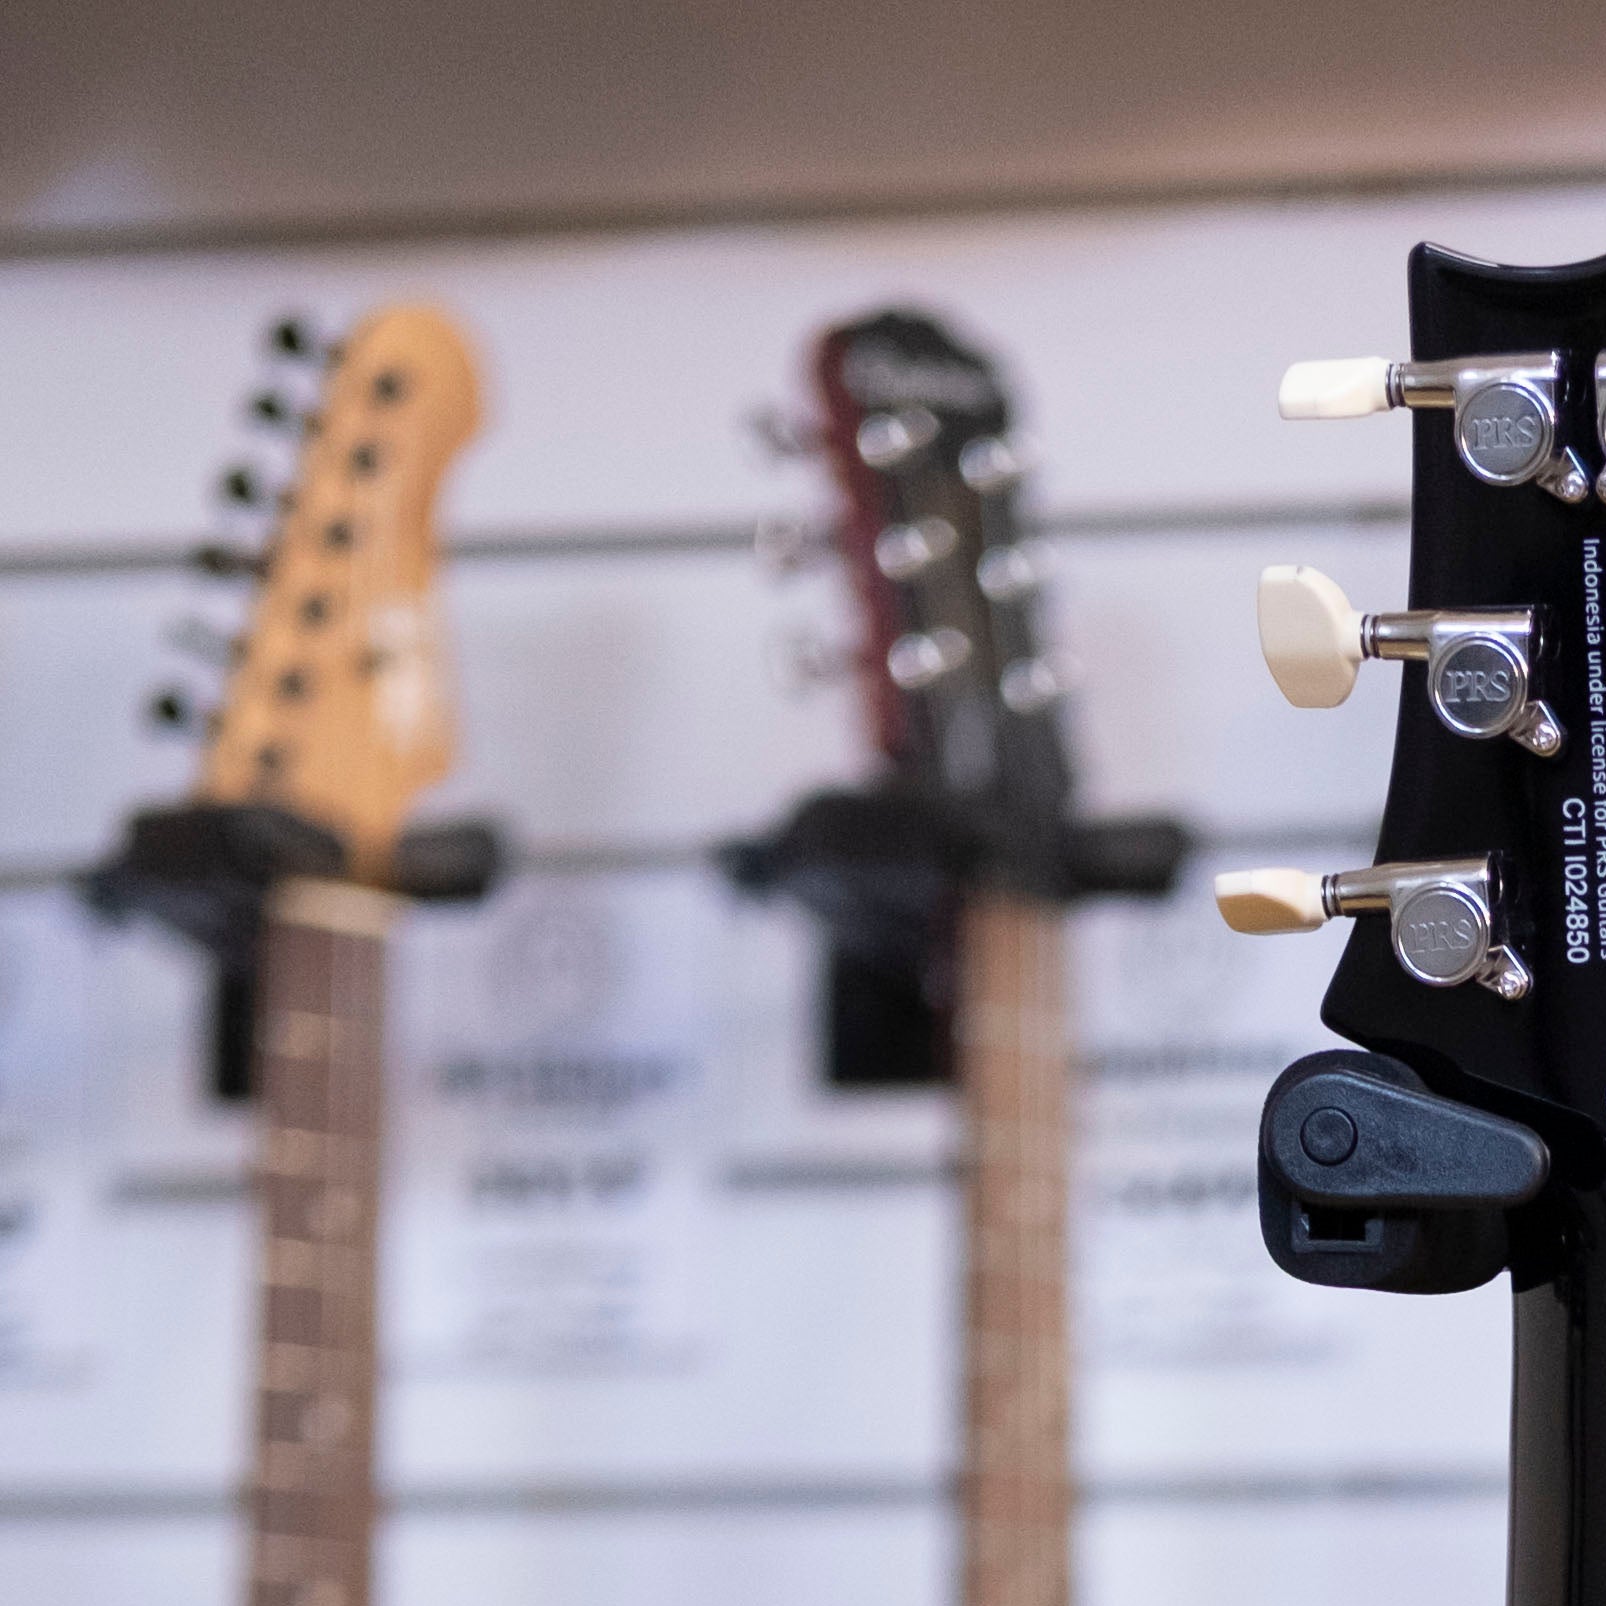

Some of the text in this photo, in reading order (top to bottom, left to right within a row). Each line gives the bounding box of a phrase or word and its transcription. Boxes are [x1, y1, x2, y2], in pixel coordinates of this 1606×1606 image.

[1471, 416, 1536, 450] PRS
[1584, 539, 1604, 644] Indonesia
[1446, 670, 1511, 703] PRS
[1588, 651, 1606, 714] under
[1563, 798, 1586, 845] CTI
[1409, 918, 1473, 954] PRS
